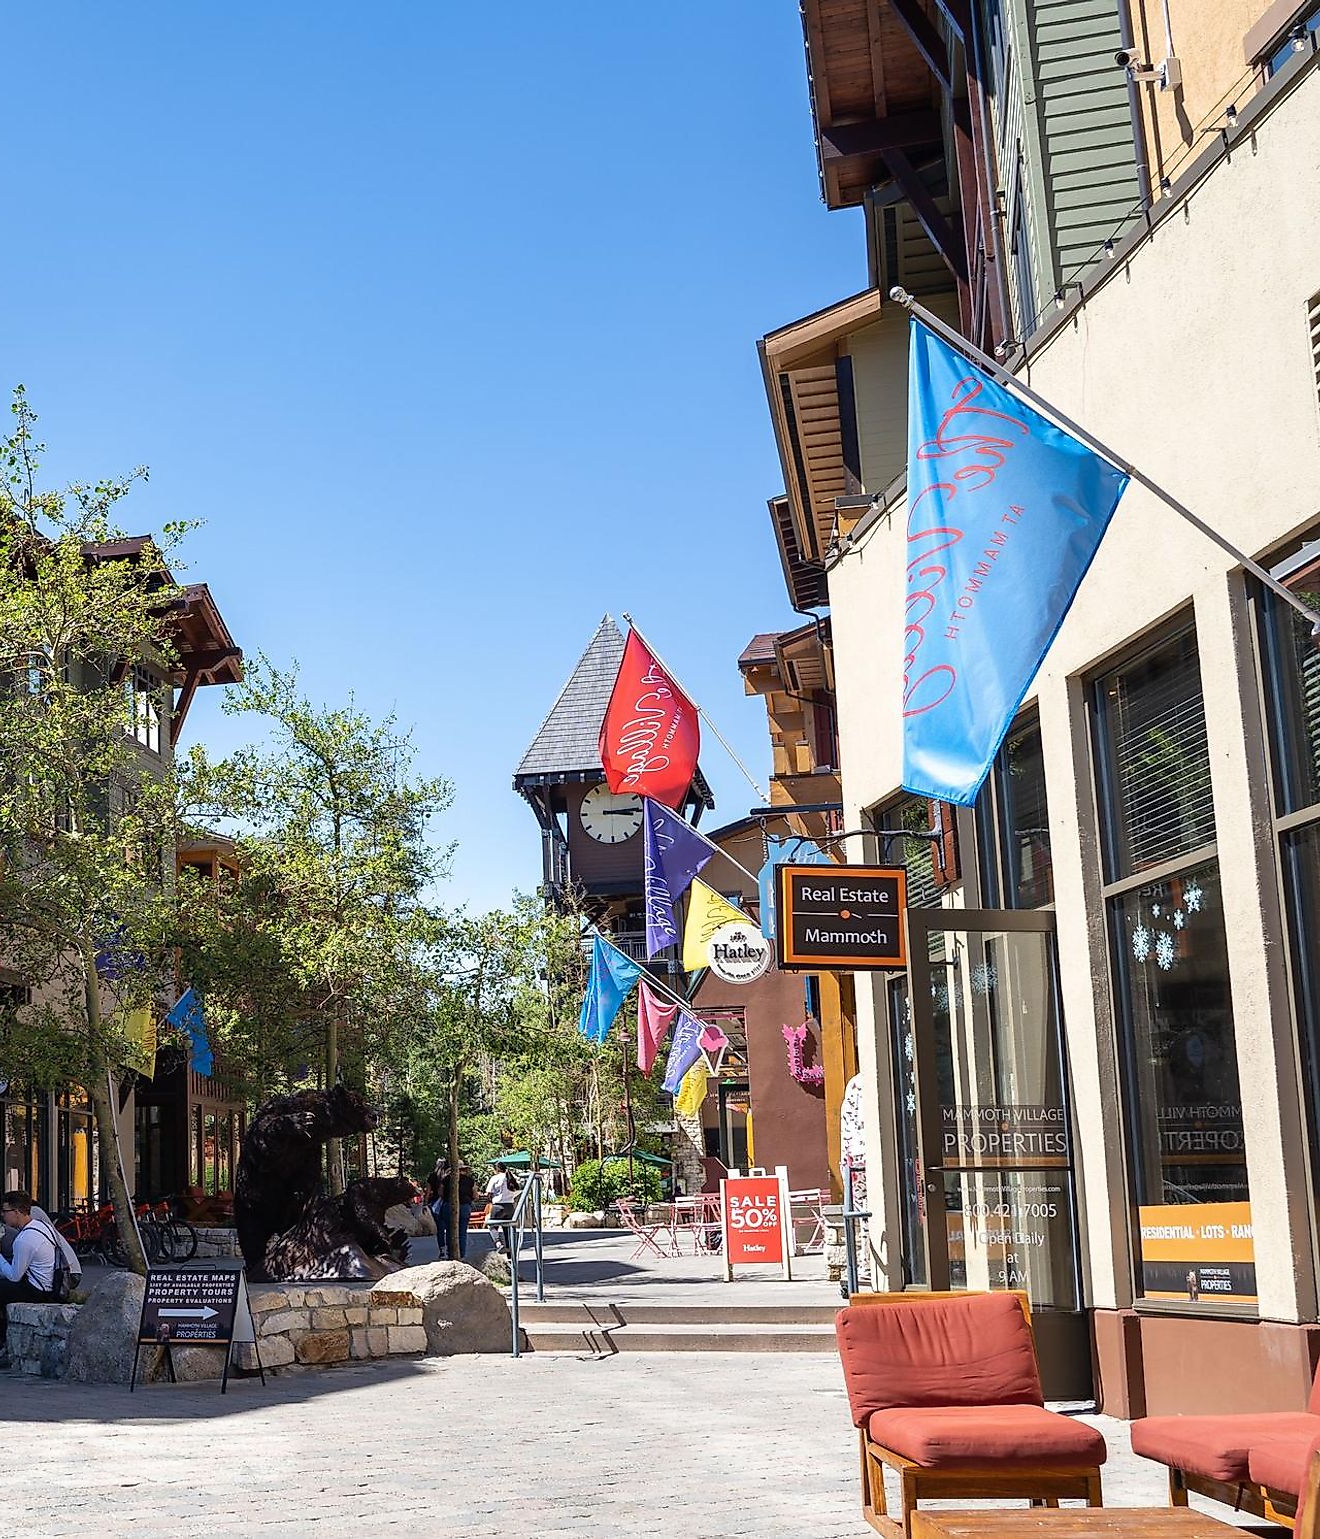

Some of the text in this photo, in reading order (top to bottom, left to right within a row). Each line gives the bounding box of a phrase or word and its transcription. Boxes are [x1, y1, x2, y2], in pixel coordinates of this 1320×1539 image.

[801, 887, 889, 903] Real Estate
[805, 928, 888, 944] Mammoth
[712, 944, 765, 962] Hatley
[943, 1108, 1064, 1121] MAMMOTH VILLAGE
[944, 1133, 1067, 1153] PROPERTIES
[729, 1195, 777, 1208] SALE
[730, 1208, 777, 1228] 50%
[1141, 1225, 1195, 1239] RESIDENTIAL
[1201, 1225, 1225, 1239] LOTS
[979, 1232, 1012, 1247] Open
[1015, 1231, 1045, 1247] Daily
[743, 1244, 766, 1253] Hatley
[1006, 1253, 1020, 1264] at
[998, 1270, 1030, 1283] 9 AM
[149, 1288, 234, 1296] PROPERTY TOURS
[176, 1330, 217, 1339] PROPERTIES
